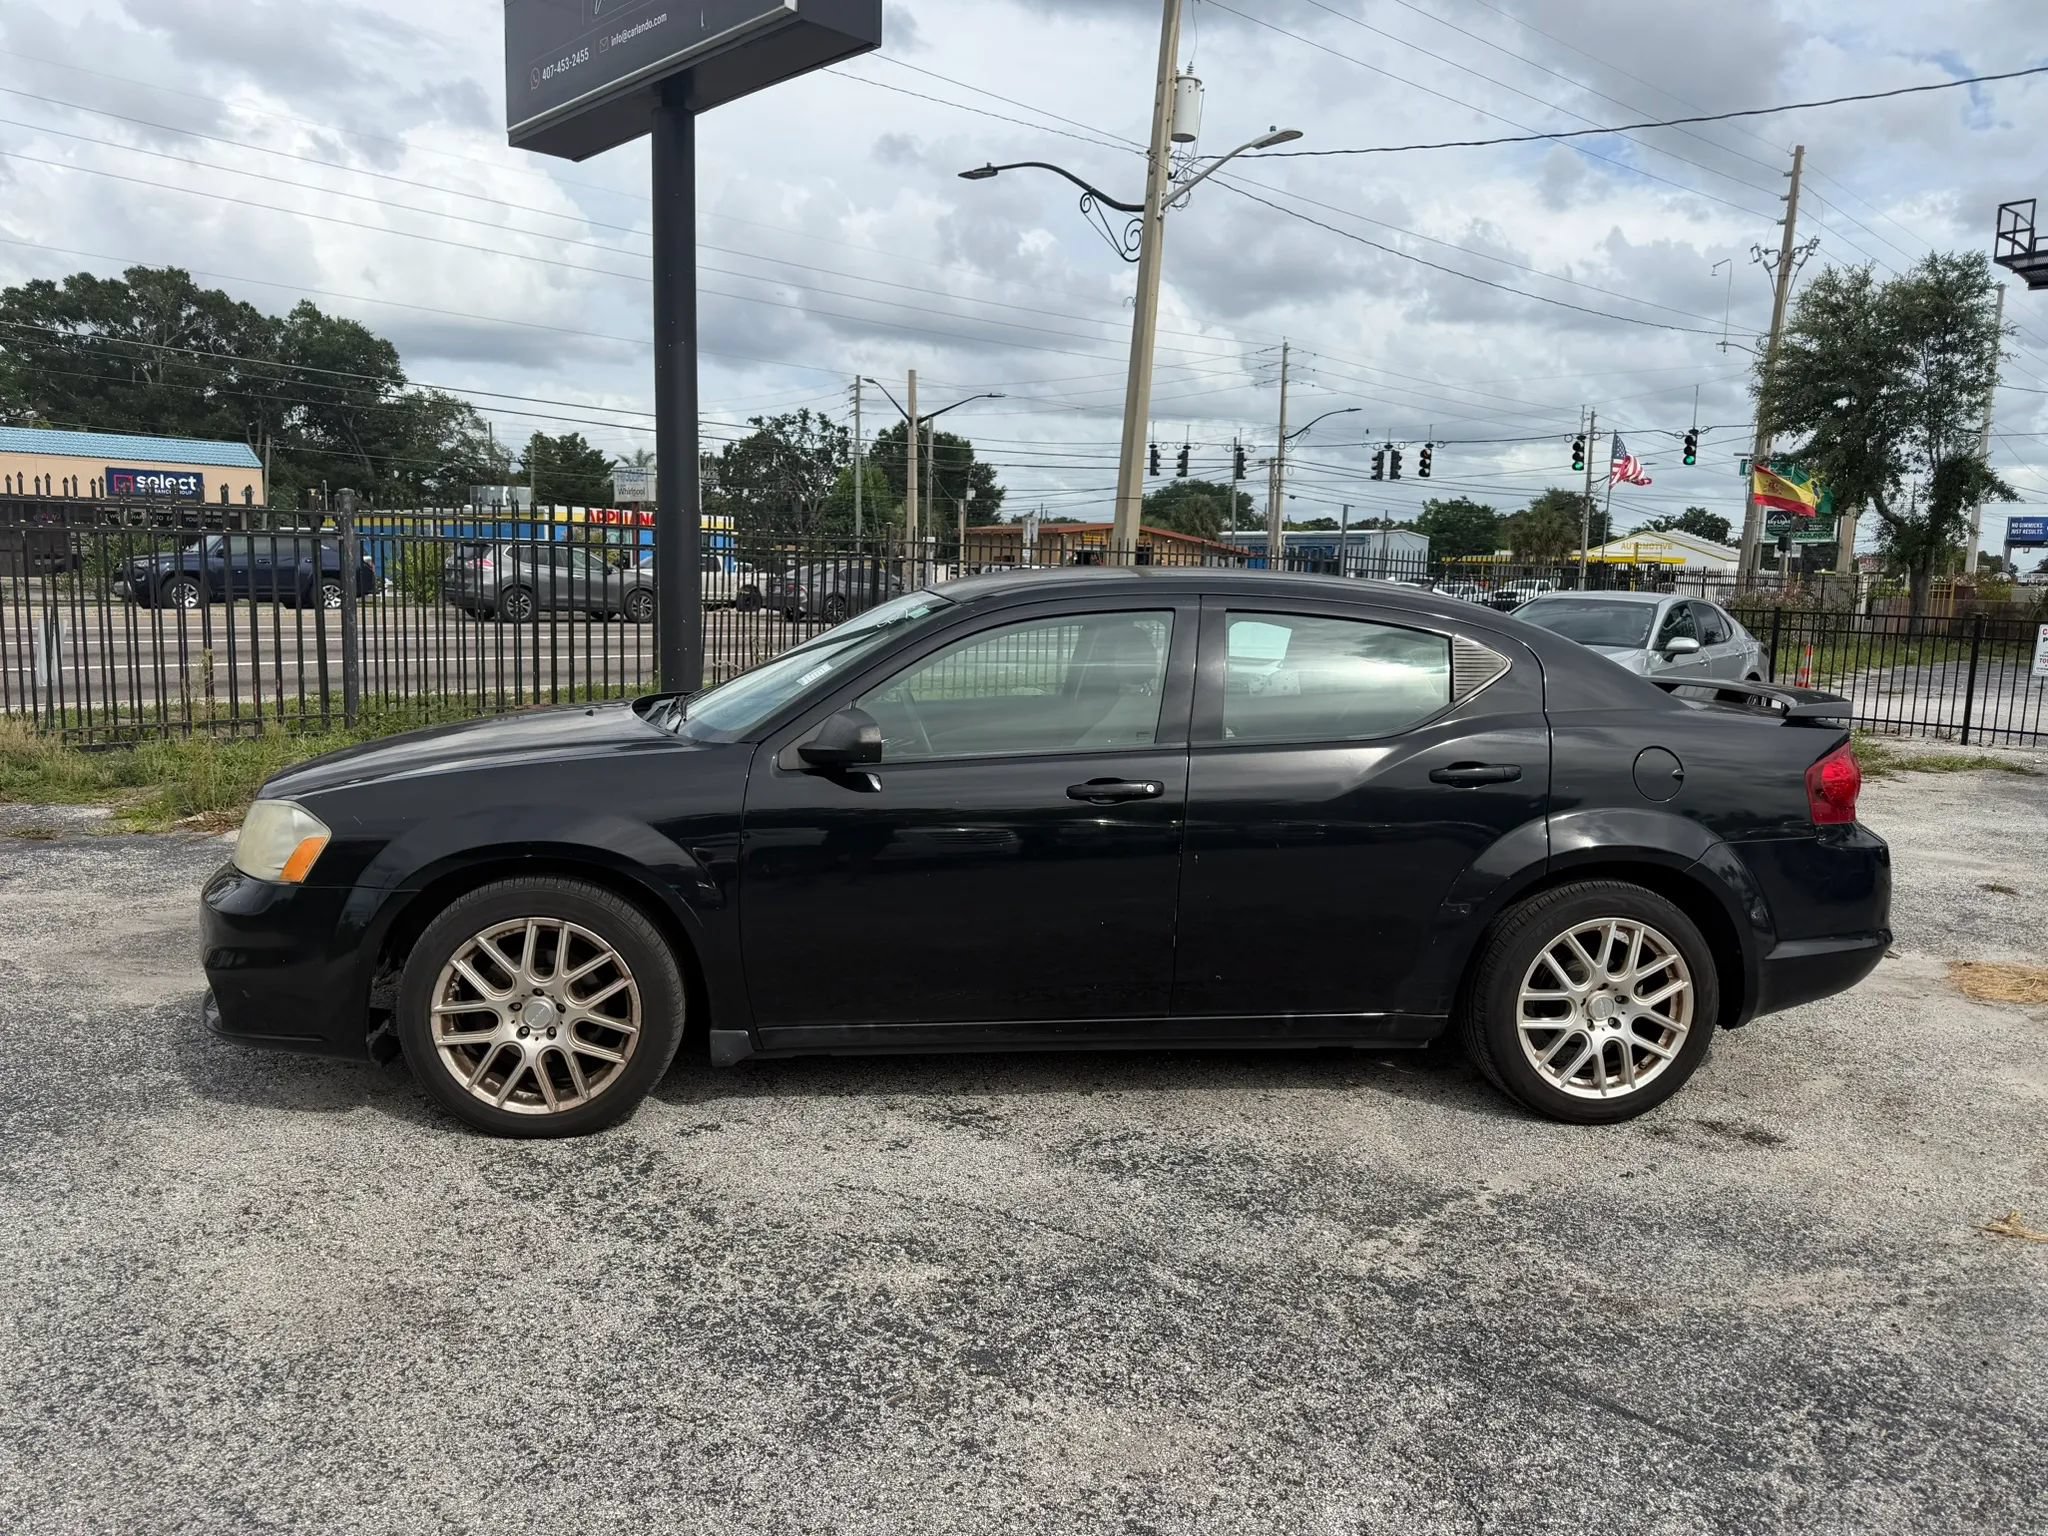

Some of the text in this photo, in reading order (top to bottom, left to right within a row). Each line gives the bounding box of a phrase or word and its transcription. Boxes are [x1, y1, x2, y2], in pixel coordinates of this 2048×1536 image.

[611, 13, 667, 47] info@carlando.com
[542, 47, 590, 80] 407-453-2455
[136, 474, 197, 490] select
